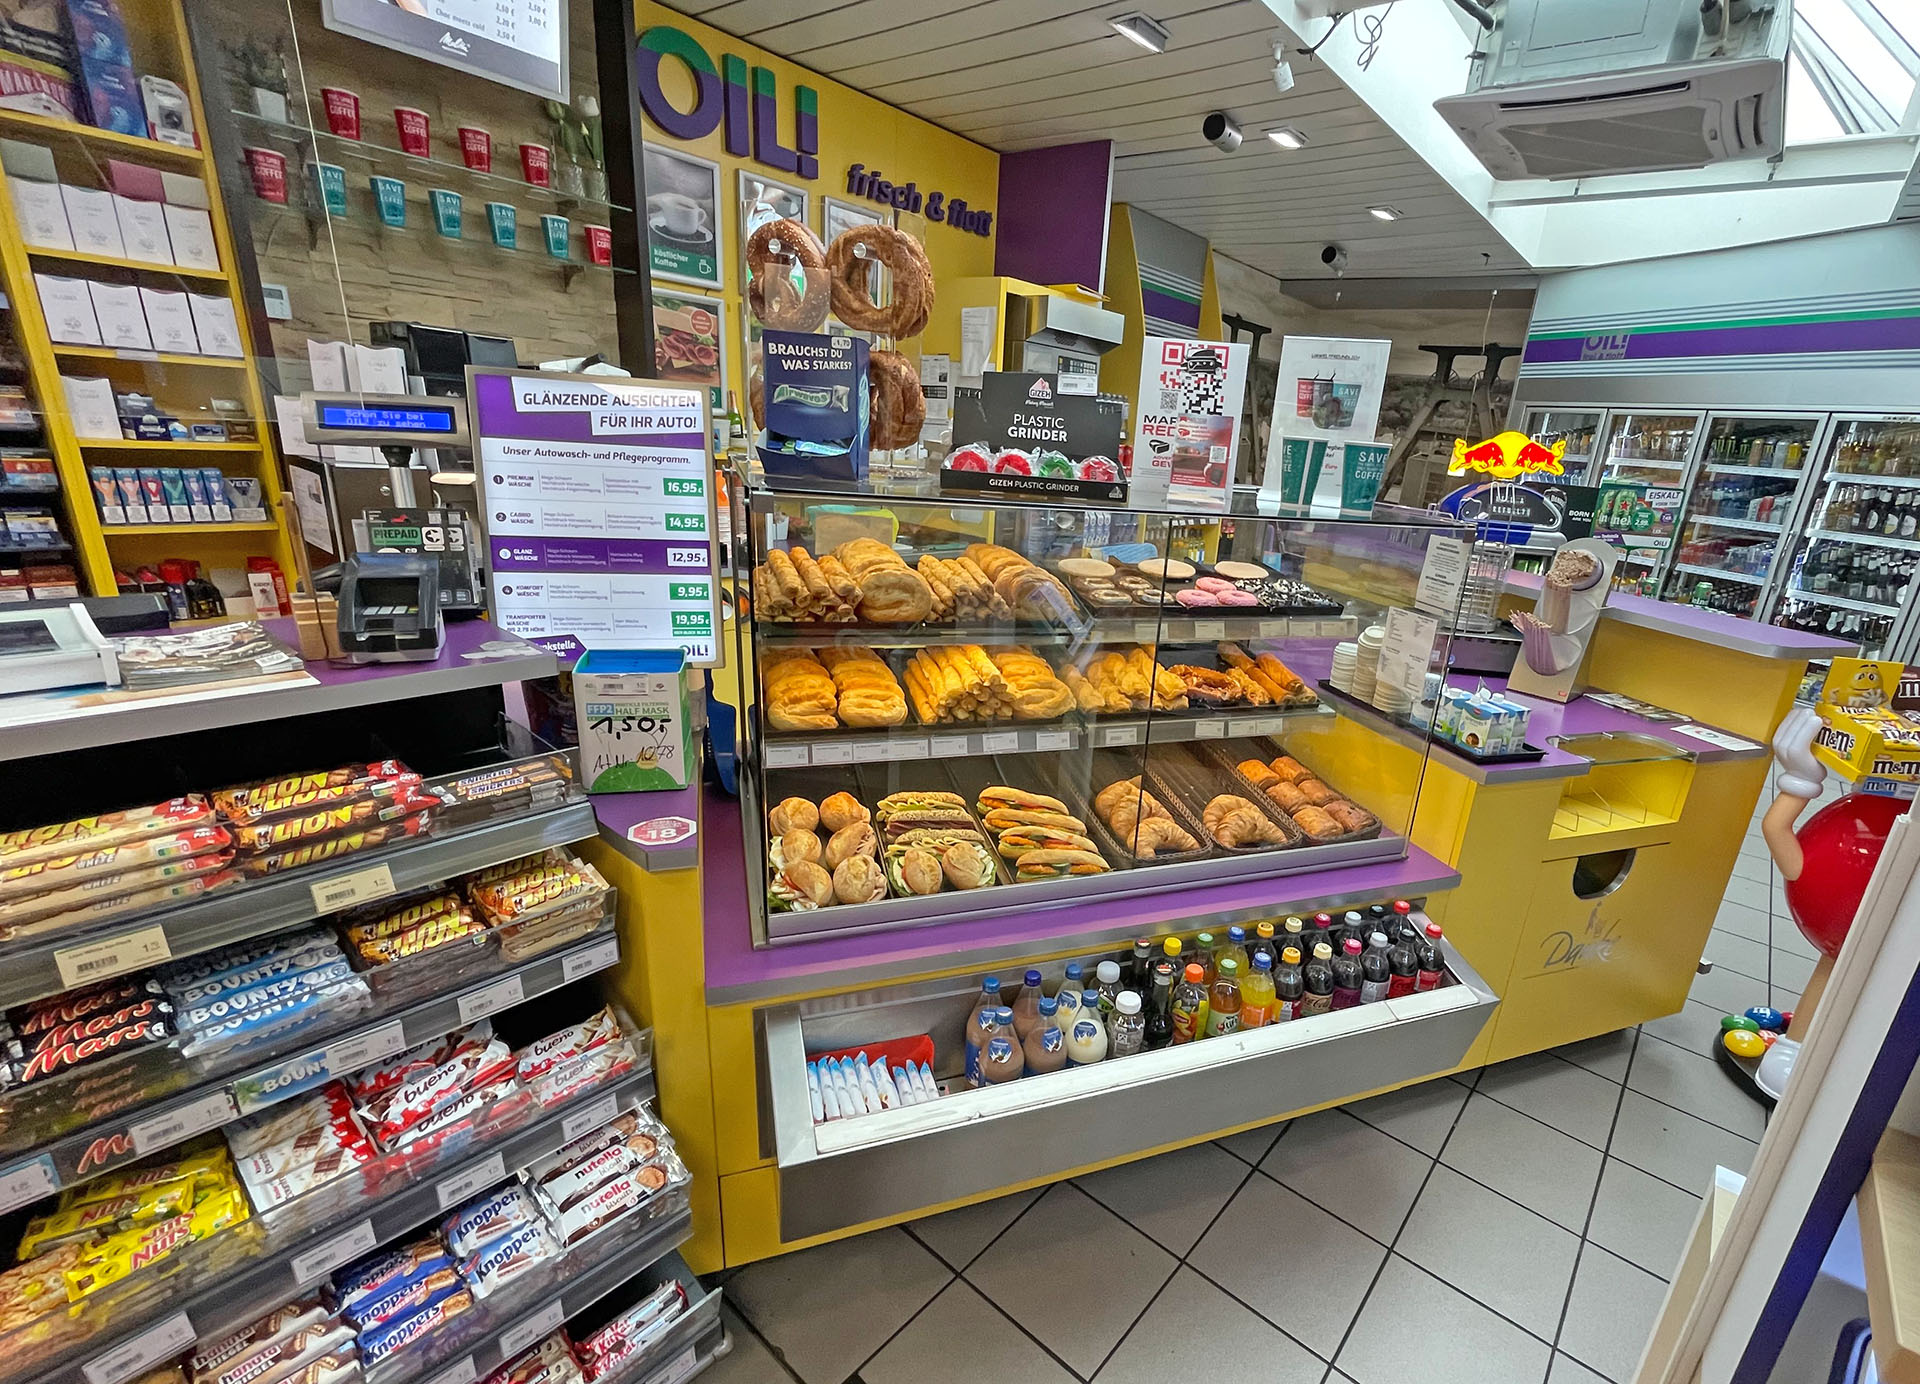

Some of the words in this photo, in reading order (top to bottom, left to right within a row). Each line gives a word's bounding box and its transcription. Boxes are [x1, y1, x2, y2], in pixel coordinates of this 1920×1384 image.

[636, 26, 819, 180] OIL!
[847, 163, 922, 214] frisch
[924, 191, 945, 222] &
[948, 198, 994, 238] flott
[654, 248, 689, 263] köstlicher
[654, 257, 678, 268] Kaffee
[768, 342, 828, 358] BRAUCHST
[830, 348, 843, 358] DU
[781, 359, 810, 371] WAS
[812, 360, 852, 371] STARKES?
[523, 391, 608, 406] GLÄNZENDE
[612, 394, 696, 408] AUSSICHTEN
[1029, 388, 1052, 399] GIZEH
[382, 411, 401, 420] Sie
[406, 412, 425, 421] bei
[600, 413, 627, 428] FÜR
[631, 416, 653, 428] IHR
[656, 416, 697, 428] AUTO!
[1013, 413, 1065, 429] PLASTIC
[1007, 426, 1068, 442] GRINDER
[502, 446, 531, 456] Unser
[534, 448, 591, 459] Autowasch-
[593, 452, 611, 460] und
[612, 452, 691, 466] Pflegeprogramm.
[1358, 451, 1388, 464] SAVE
[228, 480, 255, 488] VEEV
[508, 480, 532, 488] WÄSCHE
[989, 478, 1013, 487] GIZEH
[1014, 480, 1044, 490] PLASTIC
[1045, 482, 1079, 492] GRINDER
[1649, 491, 1680, 500] EISKALT
[373, 528, 419, 539] PREPAID
[513, 548, 533, 556] GLANZ
[514, 553, 539, 561] WÄSCHE
[587, 704, 614, 714] FFP2
[642, 707, 669, 715] MASK
[249, 771, 329, 801] LION
[460, 768, 512, 785] SNICKERS
[470, 777, 523, 796] SNICKERS
[264, 785, 346, 812] LION
[272, 804, 355, 844] LION
[647, 826, 678, 841] 18
[282, 832, 366, 868] LION
[76, 854, 117, 869] WHITE
[83, 875, 121, 890] WHITE
[506, 866, 564, 896] LION
[525, 873, 582, 910] LION
[93, 895, 131, 911] WHITE
[375, 900, 444, 937] LION
[184, 957, 292, 1003] BOUNTY
[190, 976, 301, 1025] BOUNTY
[21, 985, 137, 1036] Mars
[35, 998, 156, 1053] Mars
[21, 1020, 151, 1082] Mars
[534, 1030, 575, 1056] bueno
[404, 1062, 457, 1104] bueno
[417, 1094, 475, 1133] bueno
[574, 1146, 623, 1180] nutella
[581, 1179, 632, 1215] nutella
[605, 1187, 634, 1211] biscuits
[79, 1195, 140, 1226] Nuts
[130, 1226, 192, 1271] Nuts
[370, 1304, 442, 1363] Knoppers
[221, 1346, 280, 1384] hanuta
